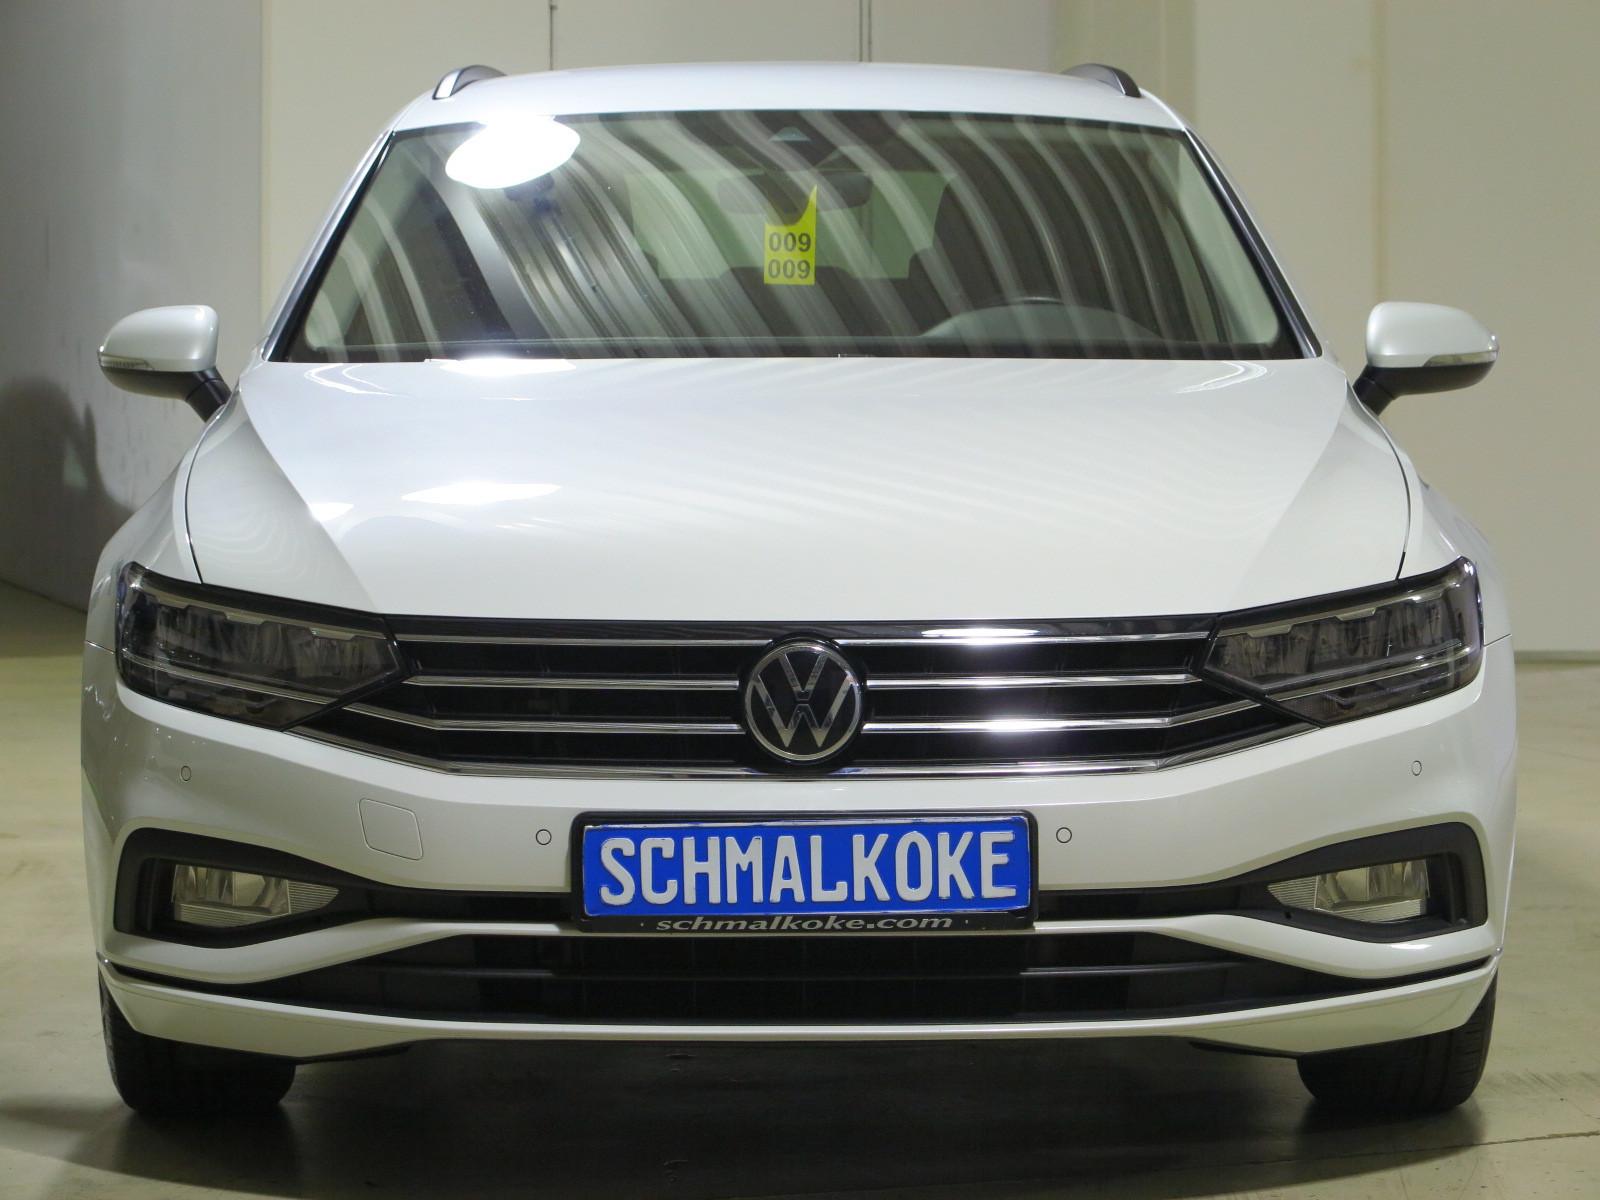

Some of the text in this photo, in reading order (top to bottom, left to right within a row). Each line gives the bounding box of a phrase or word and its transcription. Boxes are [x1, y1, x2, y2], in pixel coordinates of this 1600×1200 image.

[768, 232, 811, 253] 009
[767, 259, 811, 280] 009
[600, 830, 1017, 906] SCHMALKOKE
[656, 915, 953, 931] schmalkoke.com
